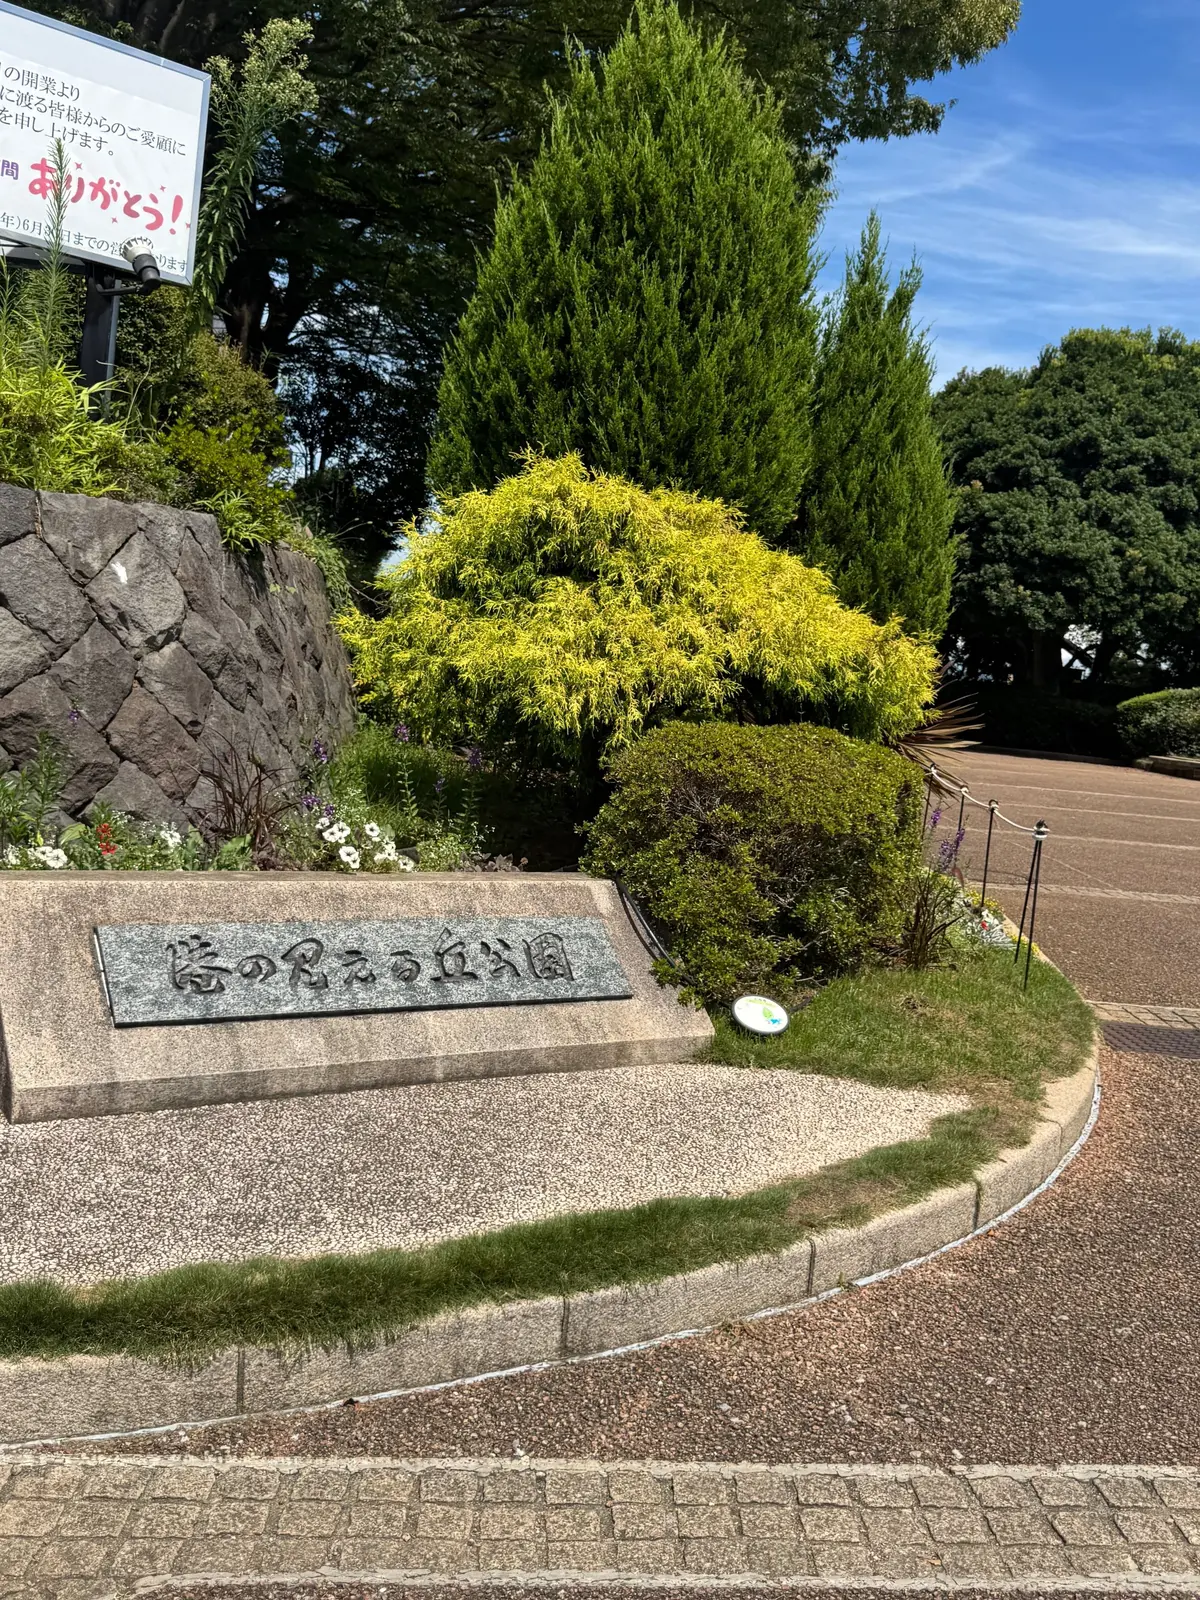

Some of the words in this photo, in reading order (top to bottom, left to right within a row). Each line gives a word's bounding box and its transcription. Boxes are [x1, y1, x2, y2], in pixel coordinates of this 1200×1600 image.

[4, 66, 80, 102] の開業より
[0, 159, 20, 180] 間
[166, 926, 575, 994] 港の見える丘公園
